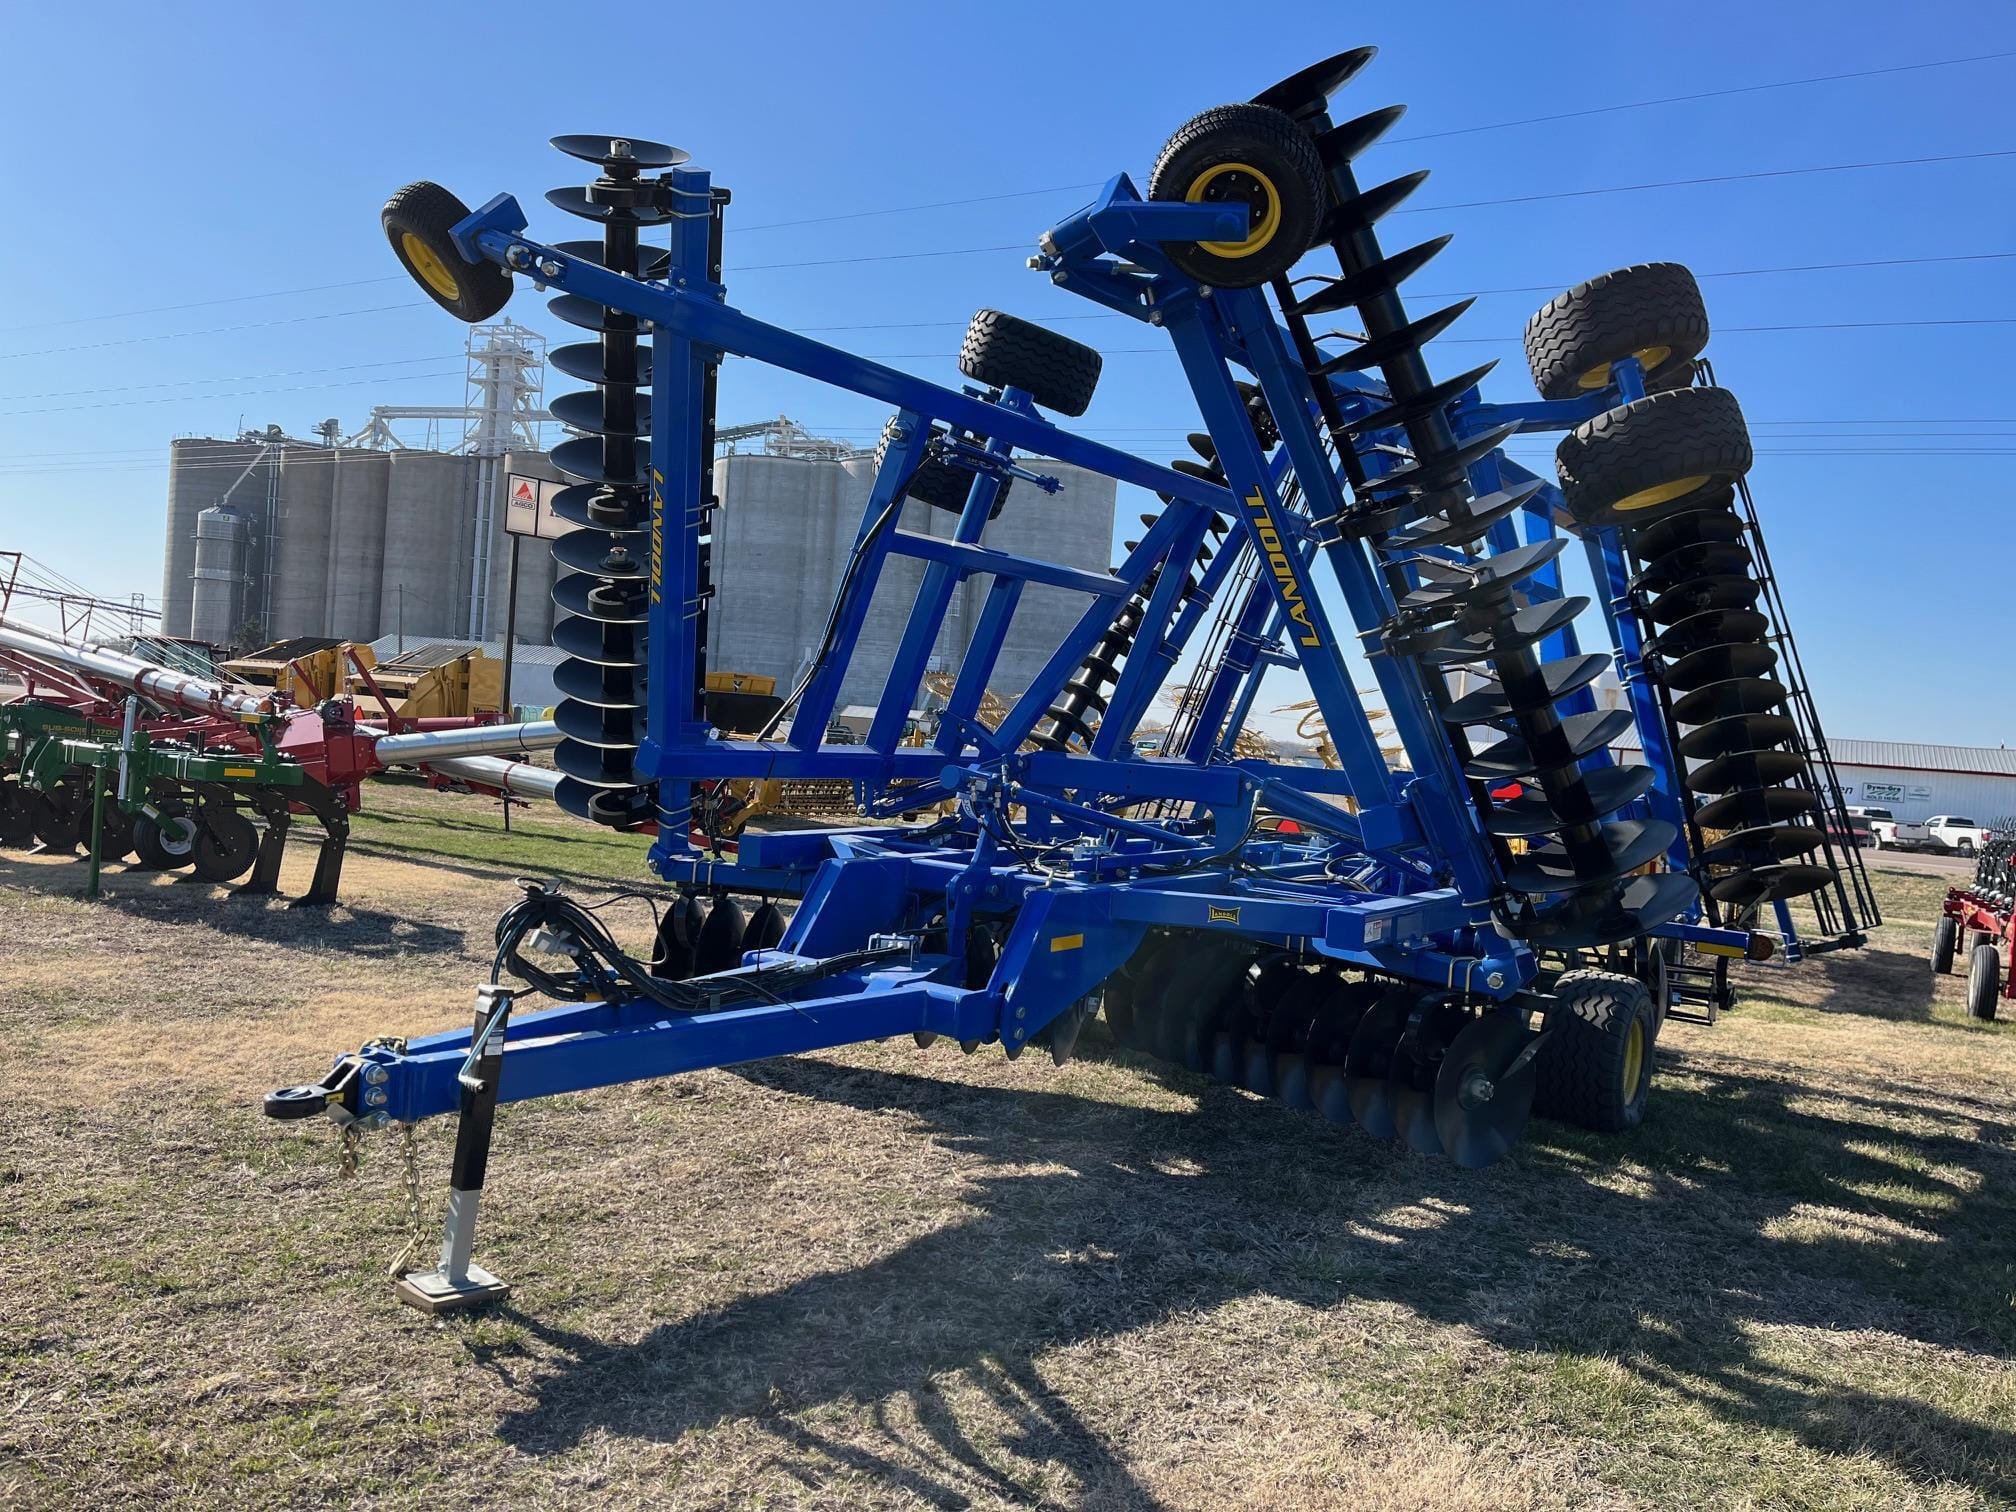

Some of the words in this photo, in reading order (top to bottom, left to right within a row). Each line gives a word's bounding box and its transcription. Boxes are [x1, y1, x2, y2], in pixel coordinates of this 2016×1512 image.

[514, 501, 534, 509] AGCO
[651, 468, 665, 605] LANDOLL
[1245, 485, 1321, 647] LANDOLL
